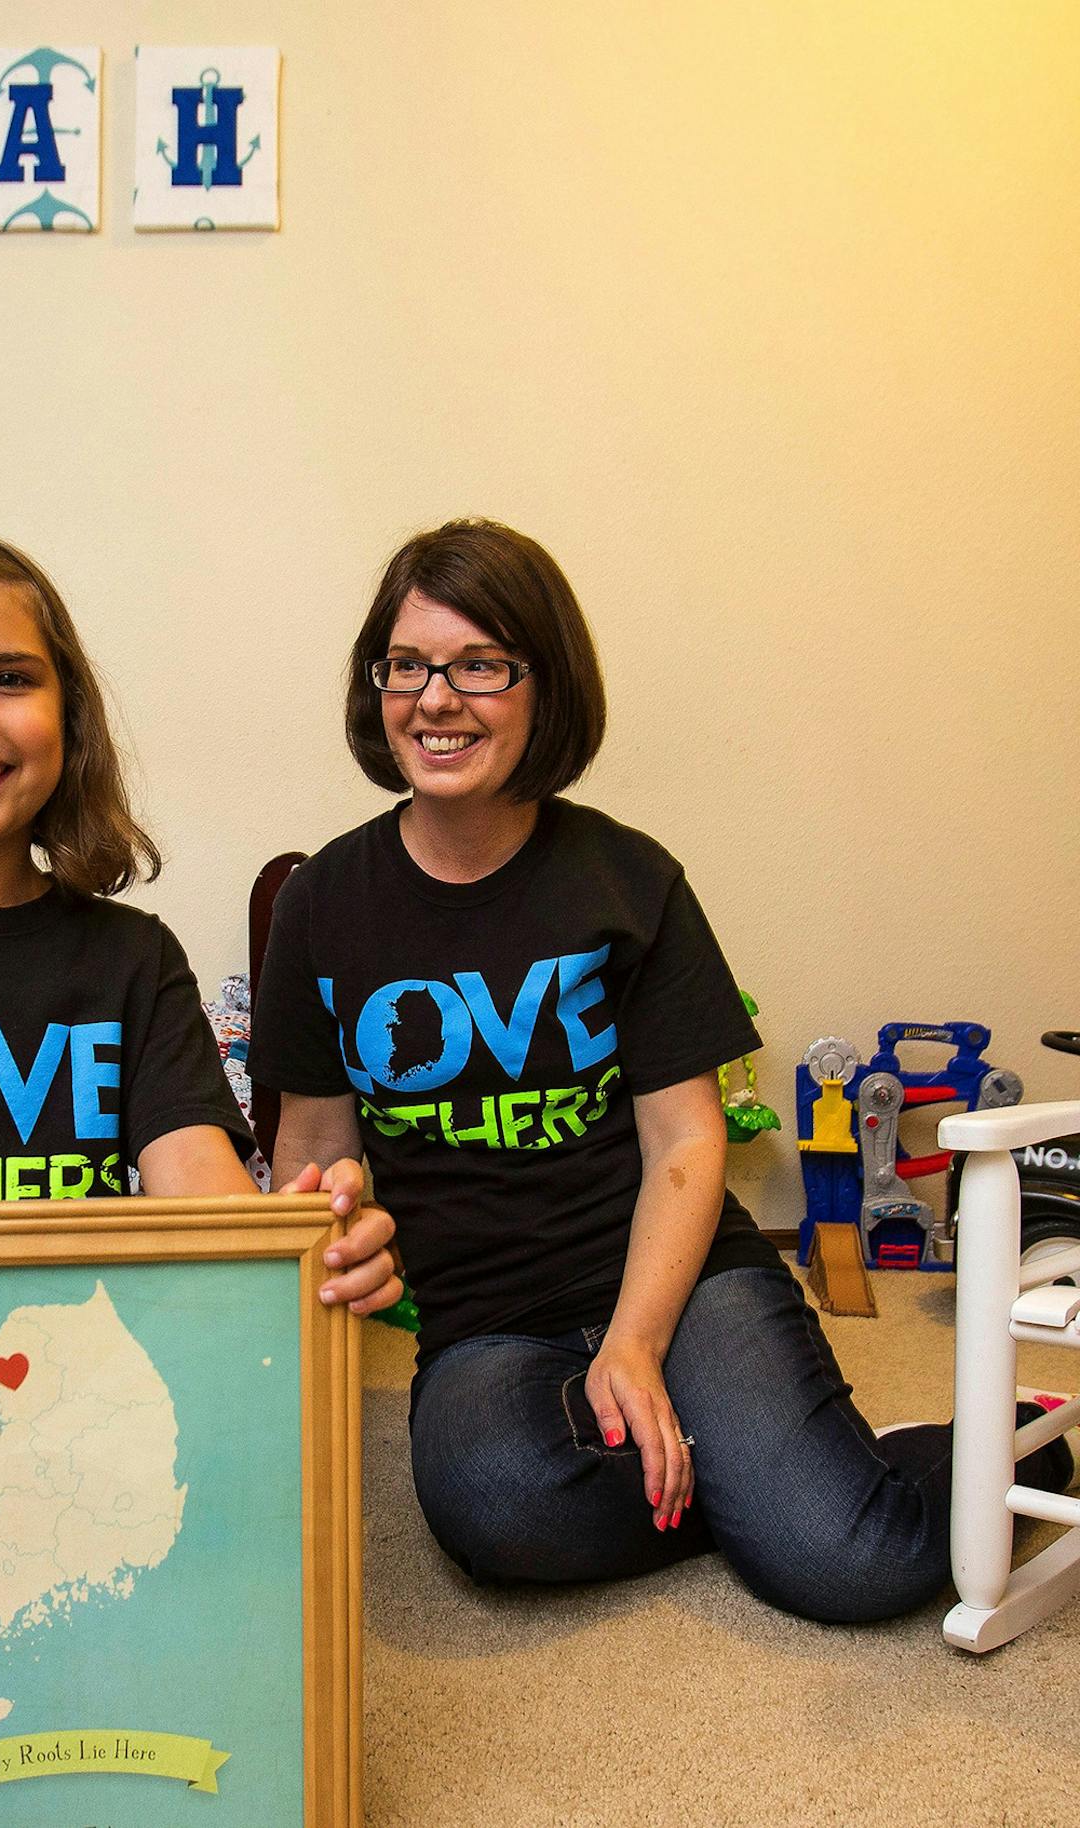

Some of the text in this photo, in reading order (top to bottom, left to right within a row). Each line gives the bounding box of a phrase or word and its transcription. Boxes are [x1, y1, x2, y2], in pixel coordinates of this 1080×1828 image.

[317, 943, 618, 1095] LOVE
[1024, 1146, 1080, 1170] NO.
[20, 1741, 71, 1765] Roots
[79, 1740, 106, 1761] Lie
[114, 1739, 157, 1761] Here
